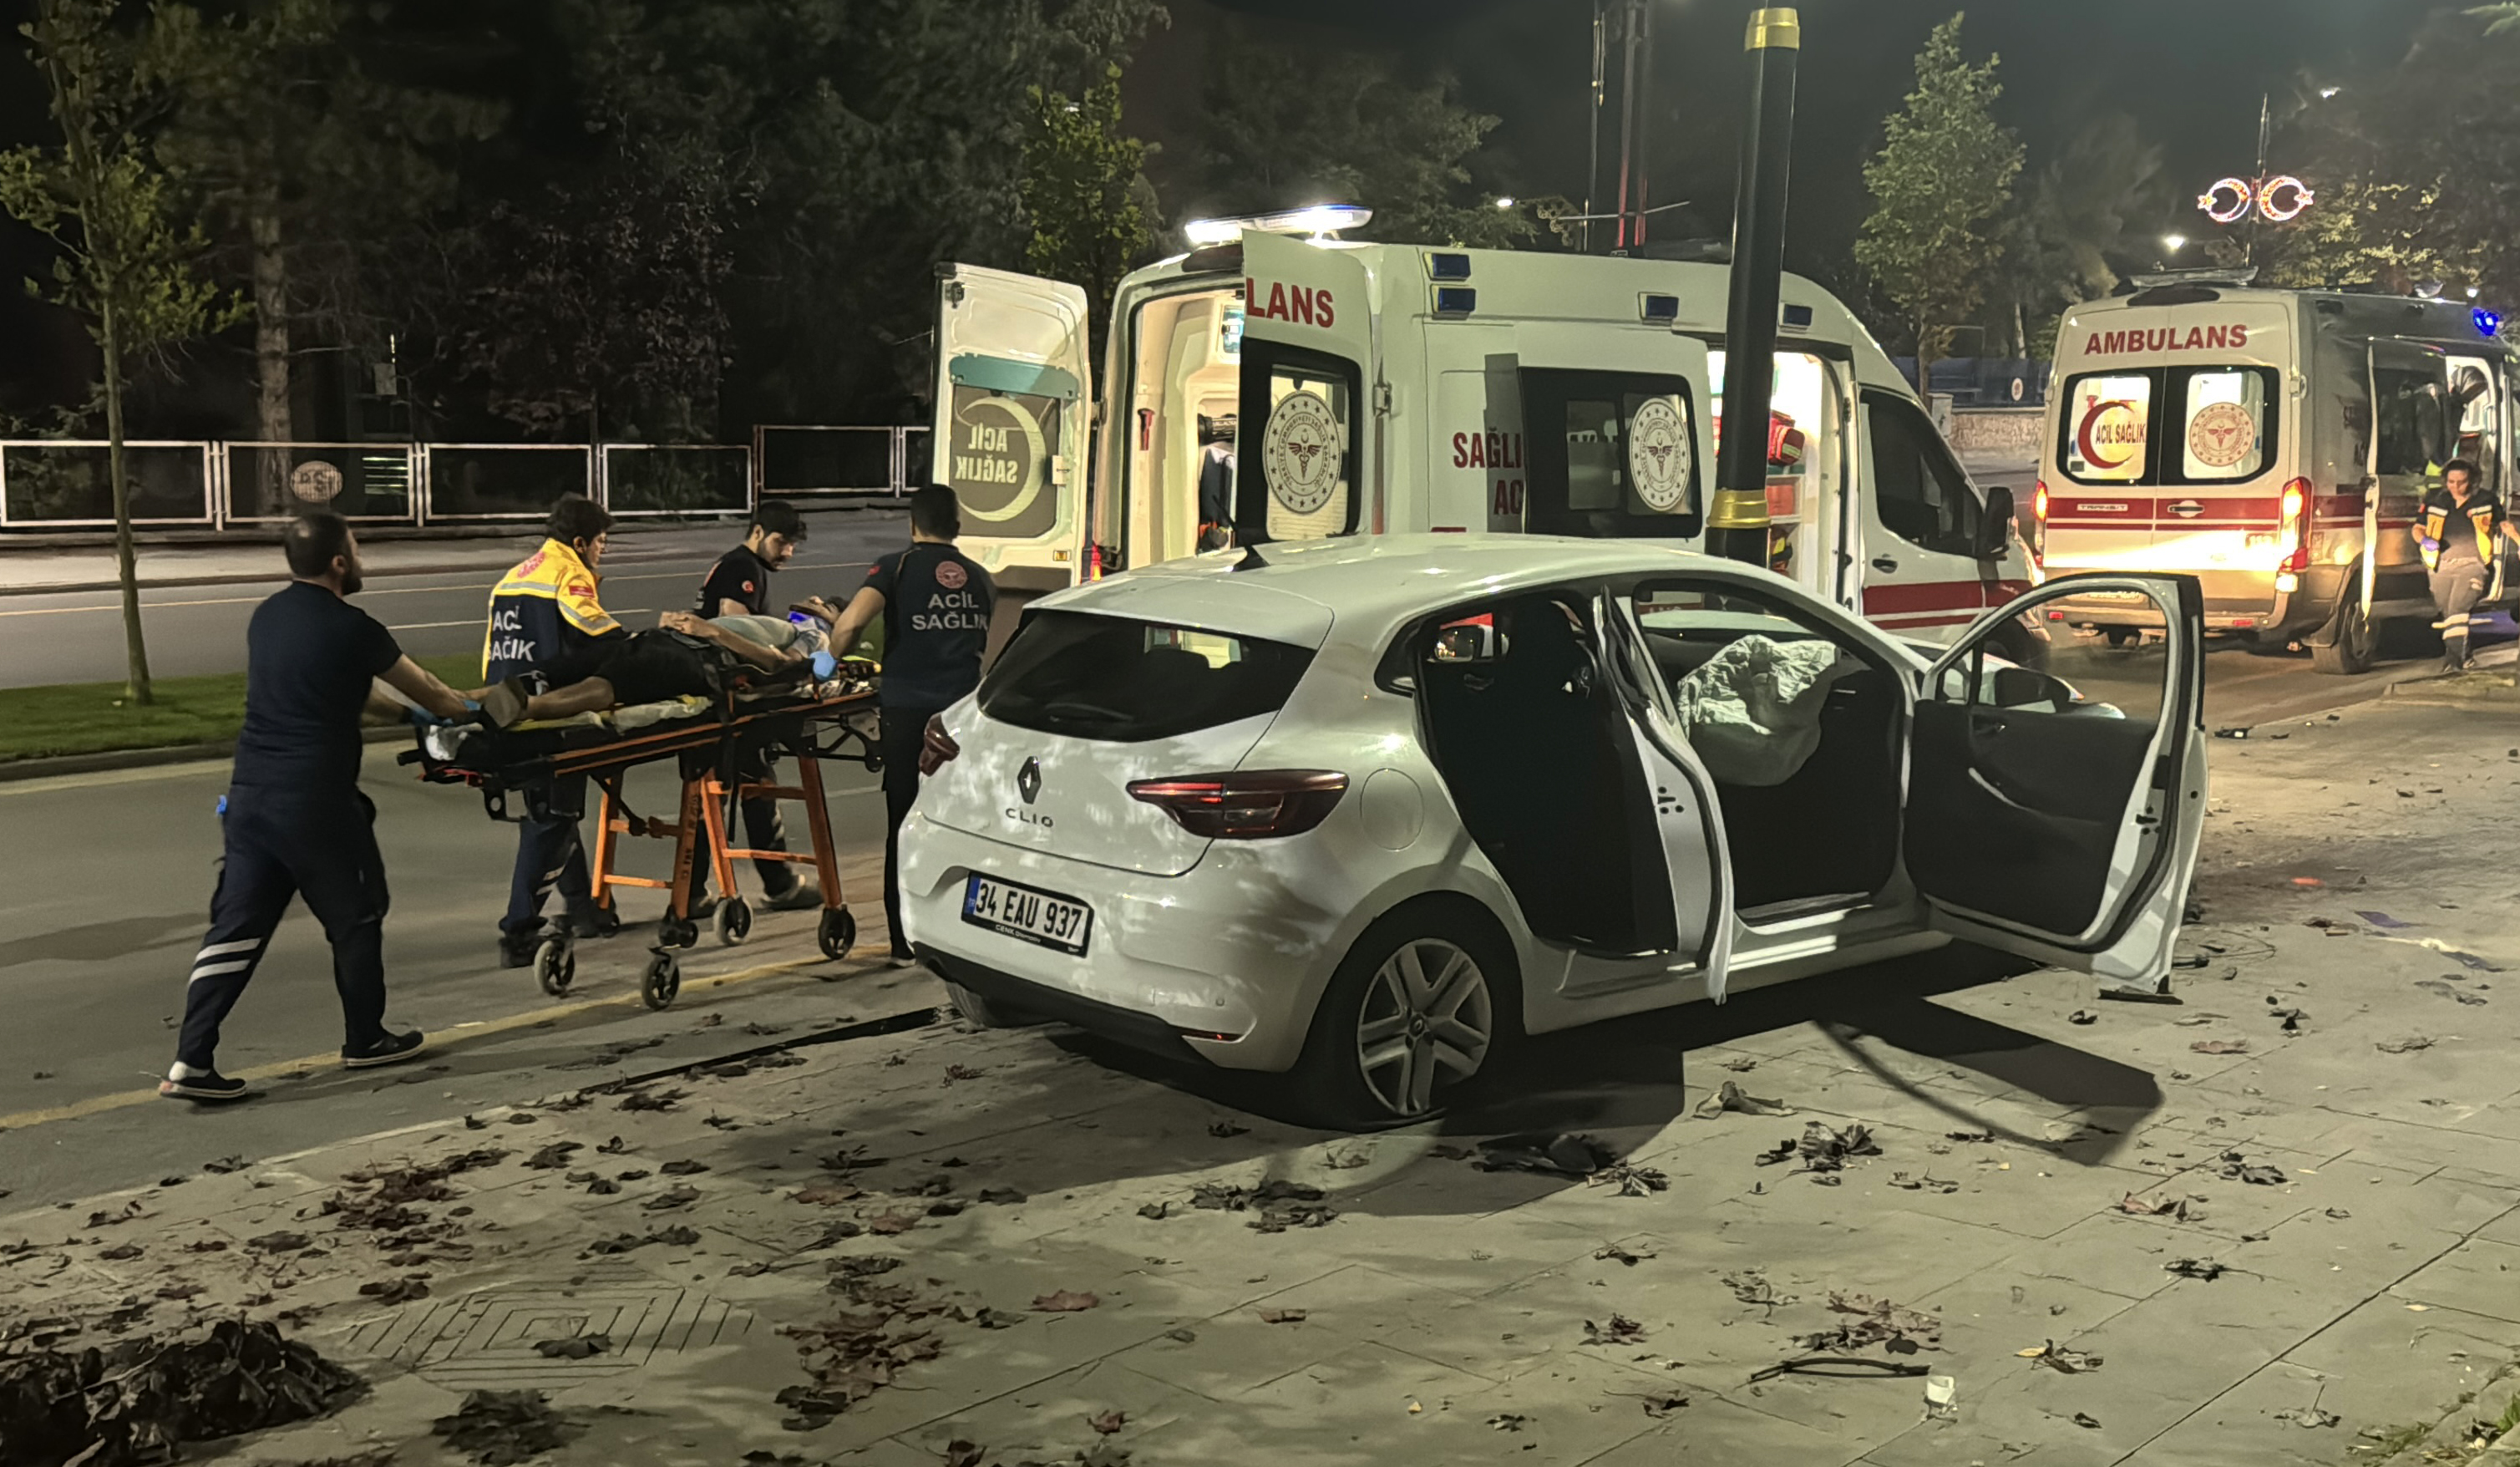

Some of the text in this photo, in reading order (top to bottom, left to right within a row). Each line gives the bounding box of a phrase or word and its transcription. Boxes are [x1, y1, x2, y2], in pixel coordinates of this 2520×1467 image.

[1246, 277, 1334, 327] LANS
[2084, 324, 2247, 355] AMBULANS
[1453, 426, 1522, 468] SAĞLI
[2096, 421, 2146, 444] ACİL SAĞLIK
[1493, 480, 1524, 515] AC
[928, 591, 979, 609] ACİL
[911, 611, 987, 631] SAĞLIK
[1006, 808, 1053, 828] CLIO
[976, 883, 1083, 940] 34 EAU 937
